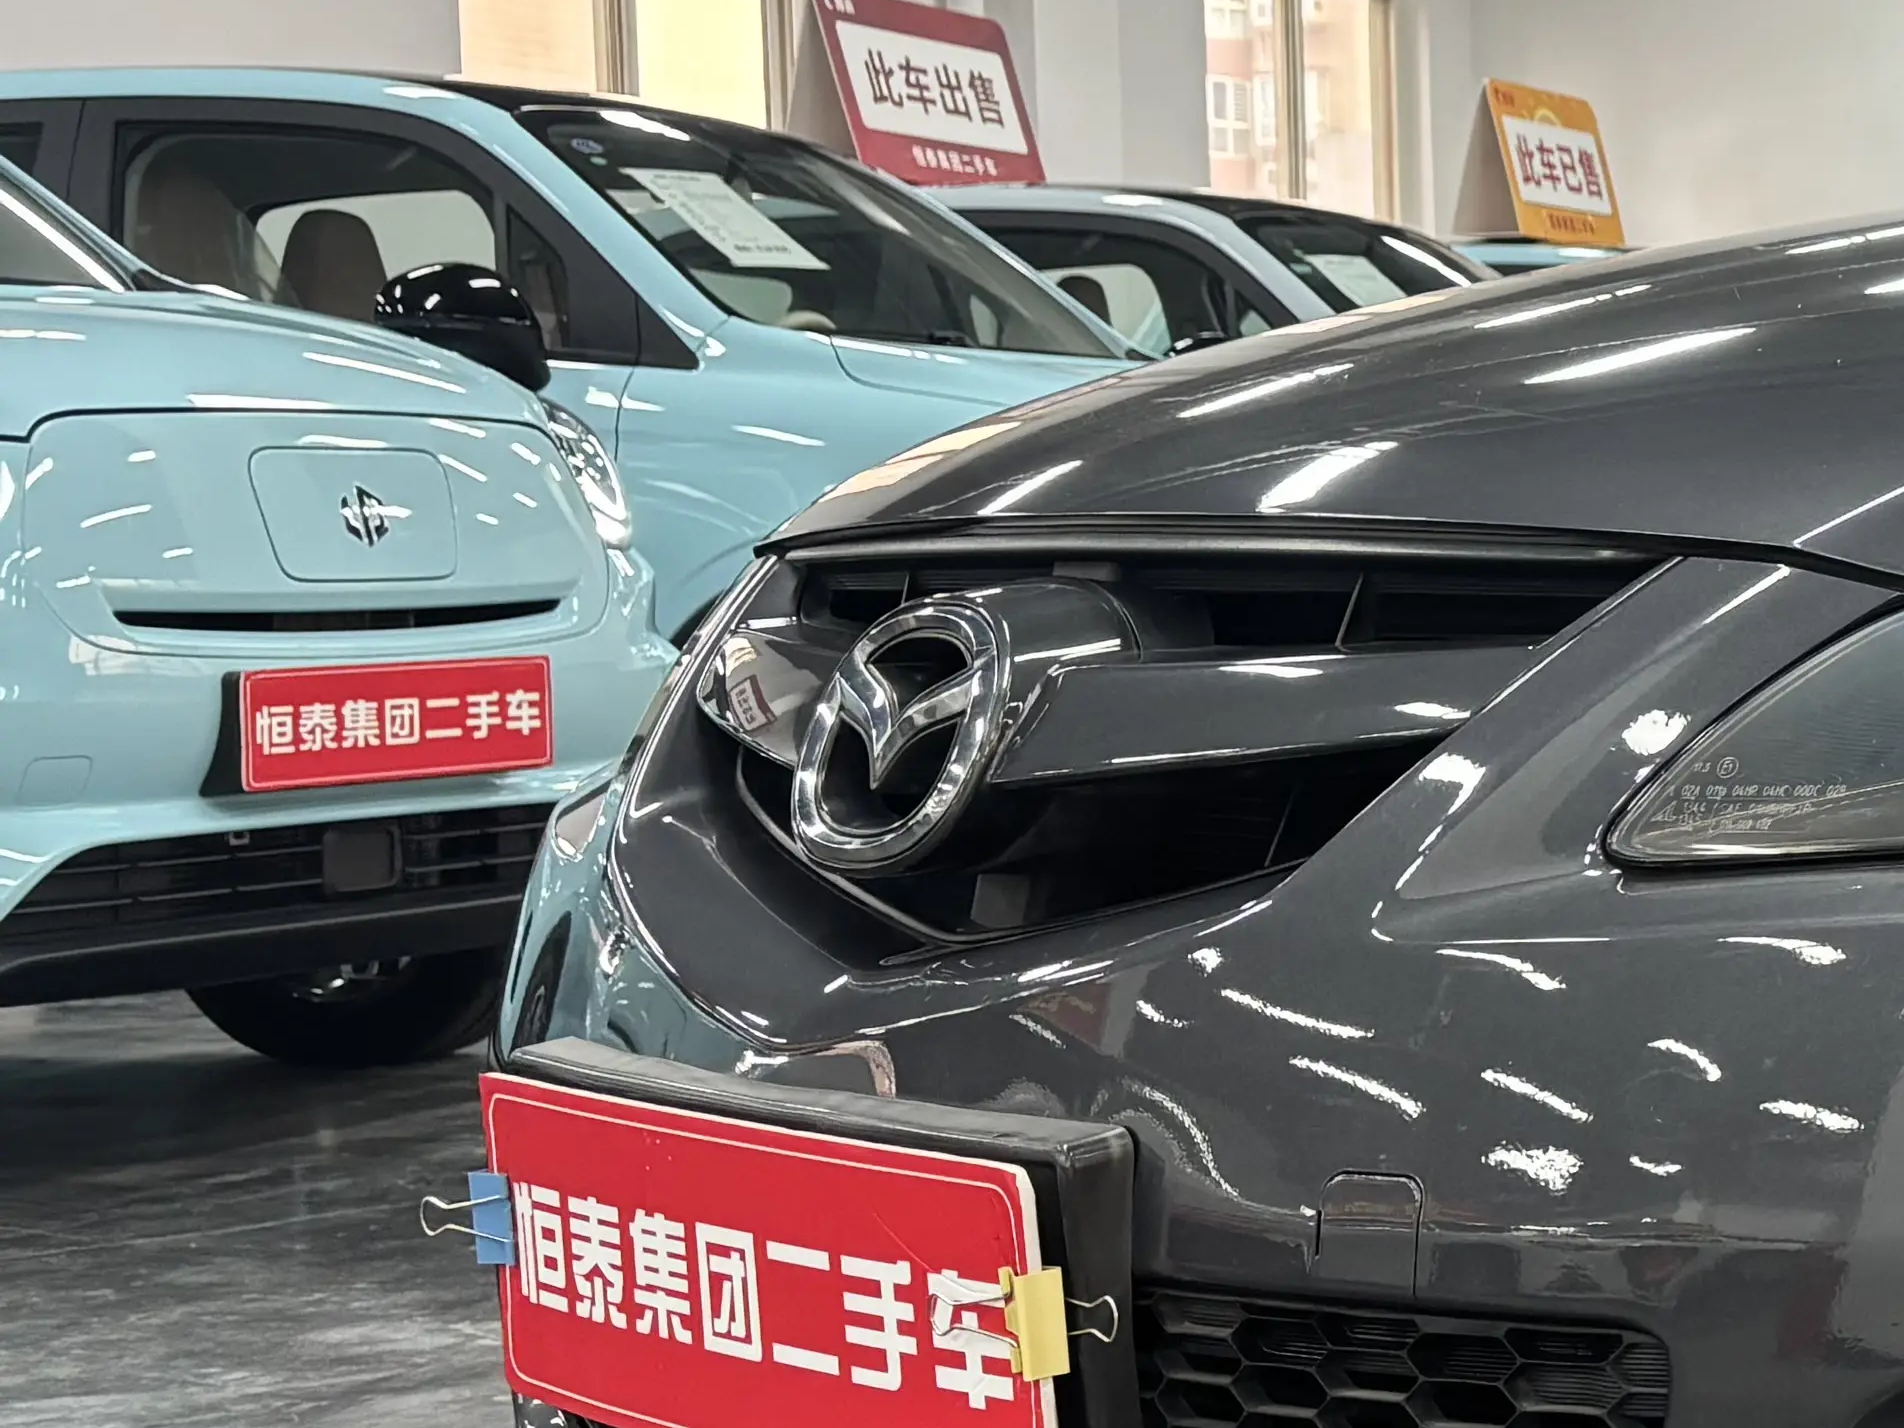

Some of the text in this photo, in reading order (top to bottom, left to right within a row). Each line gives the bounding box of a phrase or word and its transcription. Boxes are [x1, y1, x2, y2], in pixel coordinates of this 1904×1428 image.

[864, 47, 1005, 128] 此车出售
[1515, 131, 1604, 201] 此车已售
[255, 688, 542, 756] 恒泰集团二手车
[512, 1181, 1015, 1410] 恒泰集团二手车
